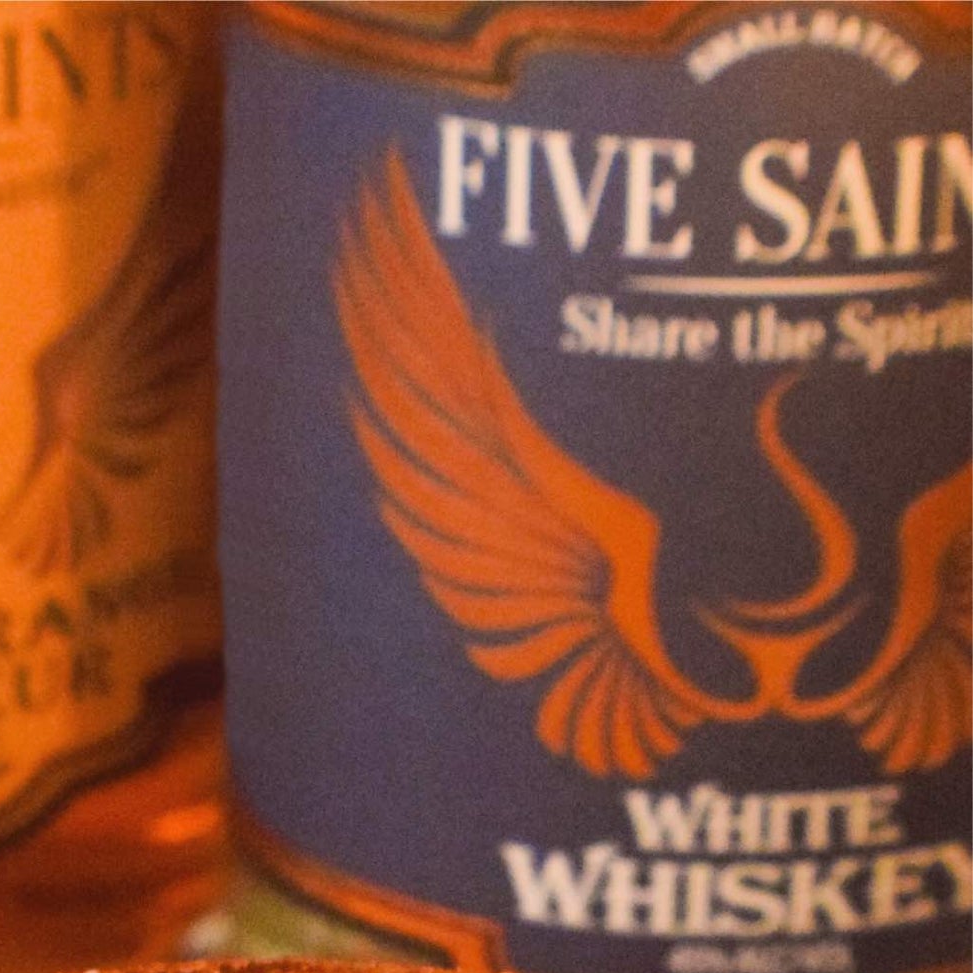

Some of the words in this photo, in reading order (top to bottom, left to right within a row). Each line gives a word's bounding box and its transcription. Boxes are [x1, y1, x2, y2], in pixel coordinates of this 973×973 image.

[438, 113, 695, 261] FIVE
[559, 292, 721, 361] Share
[731, 303, 826, 364] the
[624, 783, 904, 854] WHITE
[501, 840, 971, 937] WHISKEY
